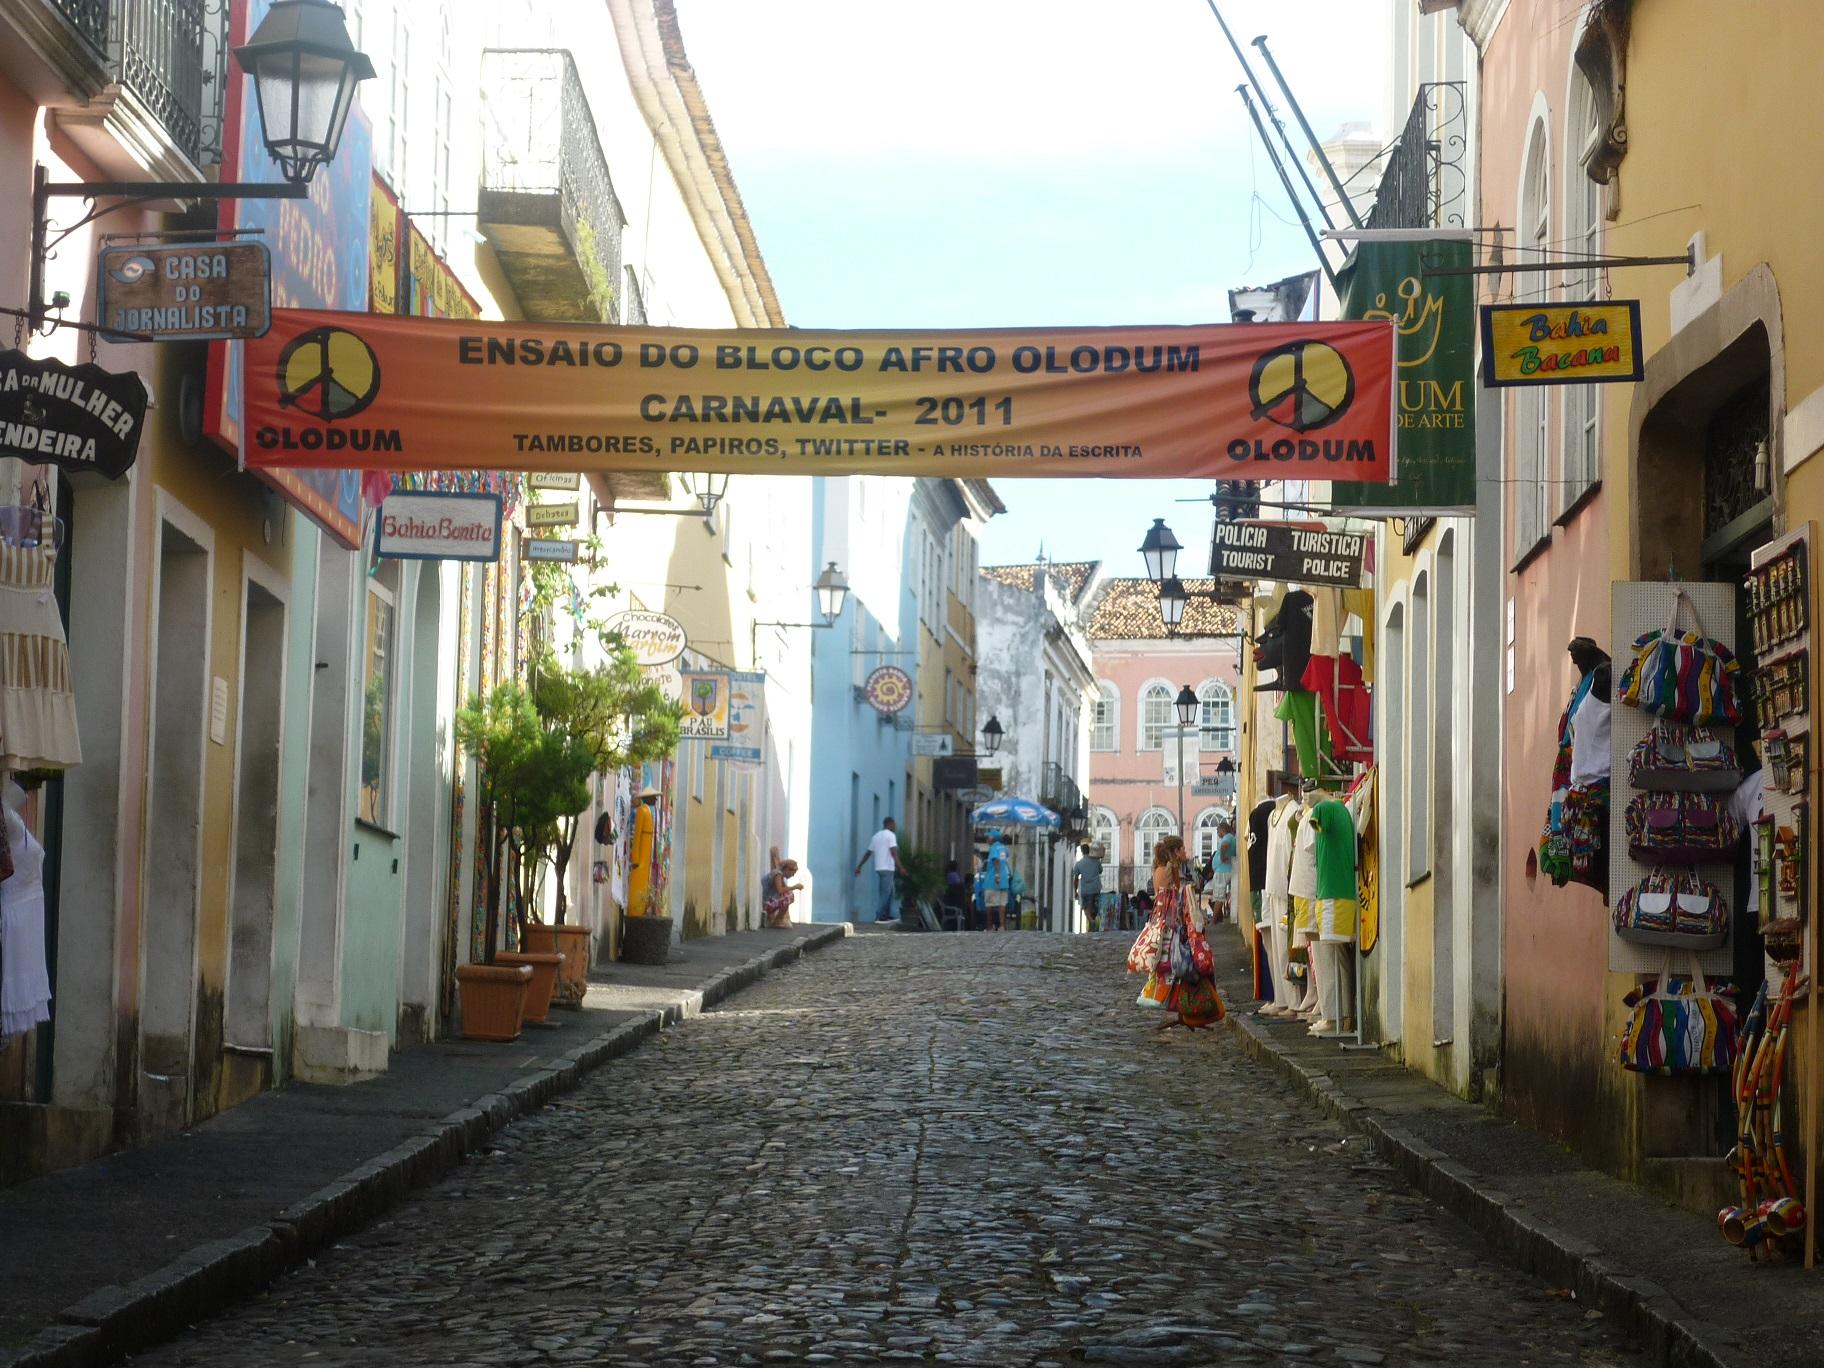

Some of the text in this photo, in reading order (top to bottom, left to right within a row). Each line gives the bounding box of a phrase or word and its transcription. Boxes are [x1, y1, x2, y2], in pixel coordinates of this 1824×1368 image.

[165, 254, 228, 280] CASA
[175, 284, 202, 302] DO
[113, 304, 247, 332] JORNALISTA
[1520, 311, 1608, 342] Bahia
[458, 336, 1200, 374] ENSAIO DO BLOCO AFRO OLODUM
[1511, 345, 1620, 375] Bacana
[0, 368, 134, 441] A DA MULHER
[640, 394, 1013, 426] CARNAVAL- 2011
[1418, 413, 1465, 429] ARTE
[256, 427, 402, 452] OLODUM
[513, 434, 661, 457] TAMBORES,
[670, 437, 787, 458] PAPIROS,
[796, 439, 910, 457] TWITTER
[933, 445, 945, 457] A
[951, 441, 1034, 458] HISTÓRIA
[1039, 445, 1062, 458] DA
[1068, 445, 1143, 458] ESCRITA
[1227, 438, 1376, 463] OLODUM
[382, 515, 492, 542] Bahia Bonita
[1216, 523, 1361, 557] POLÍCIA TURÍSTICA
[1222, 550, 1351, 578] TOURIST POLICE
[611, 621, 682, 642] Marrom
[622, 612, 679, 631] Chocolates
[624, 634, 678, 656] arfim
[679, 726, 725, 737] BRASILIS
[690, 717, 713, 727] PAU
